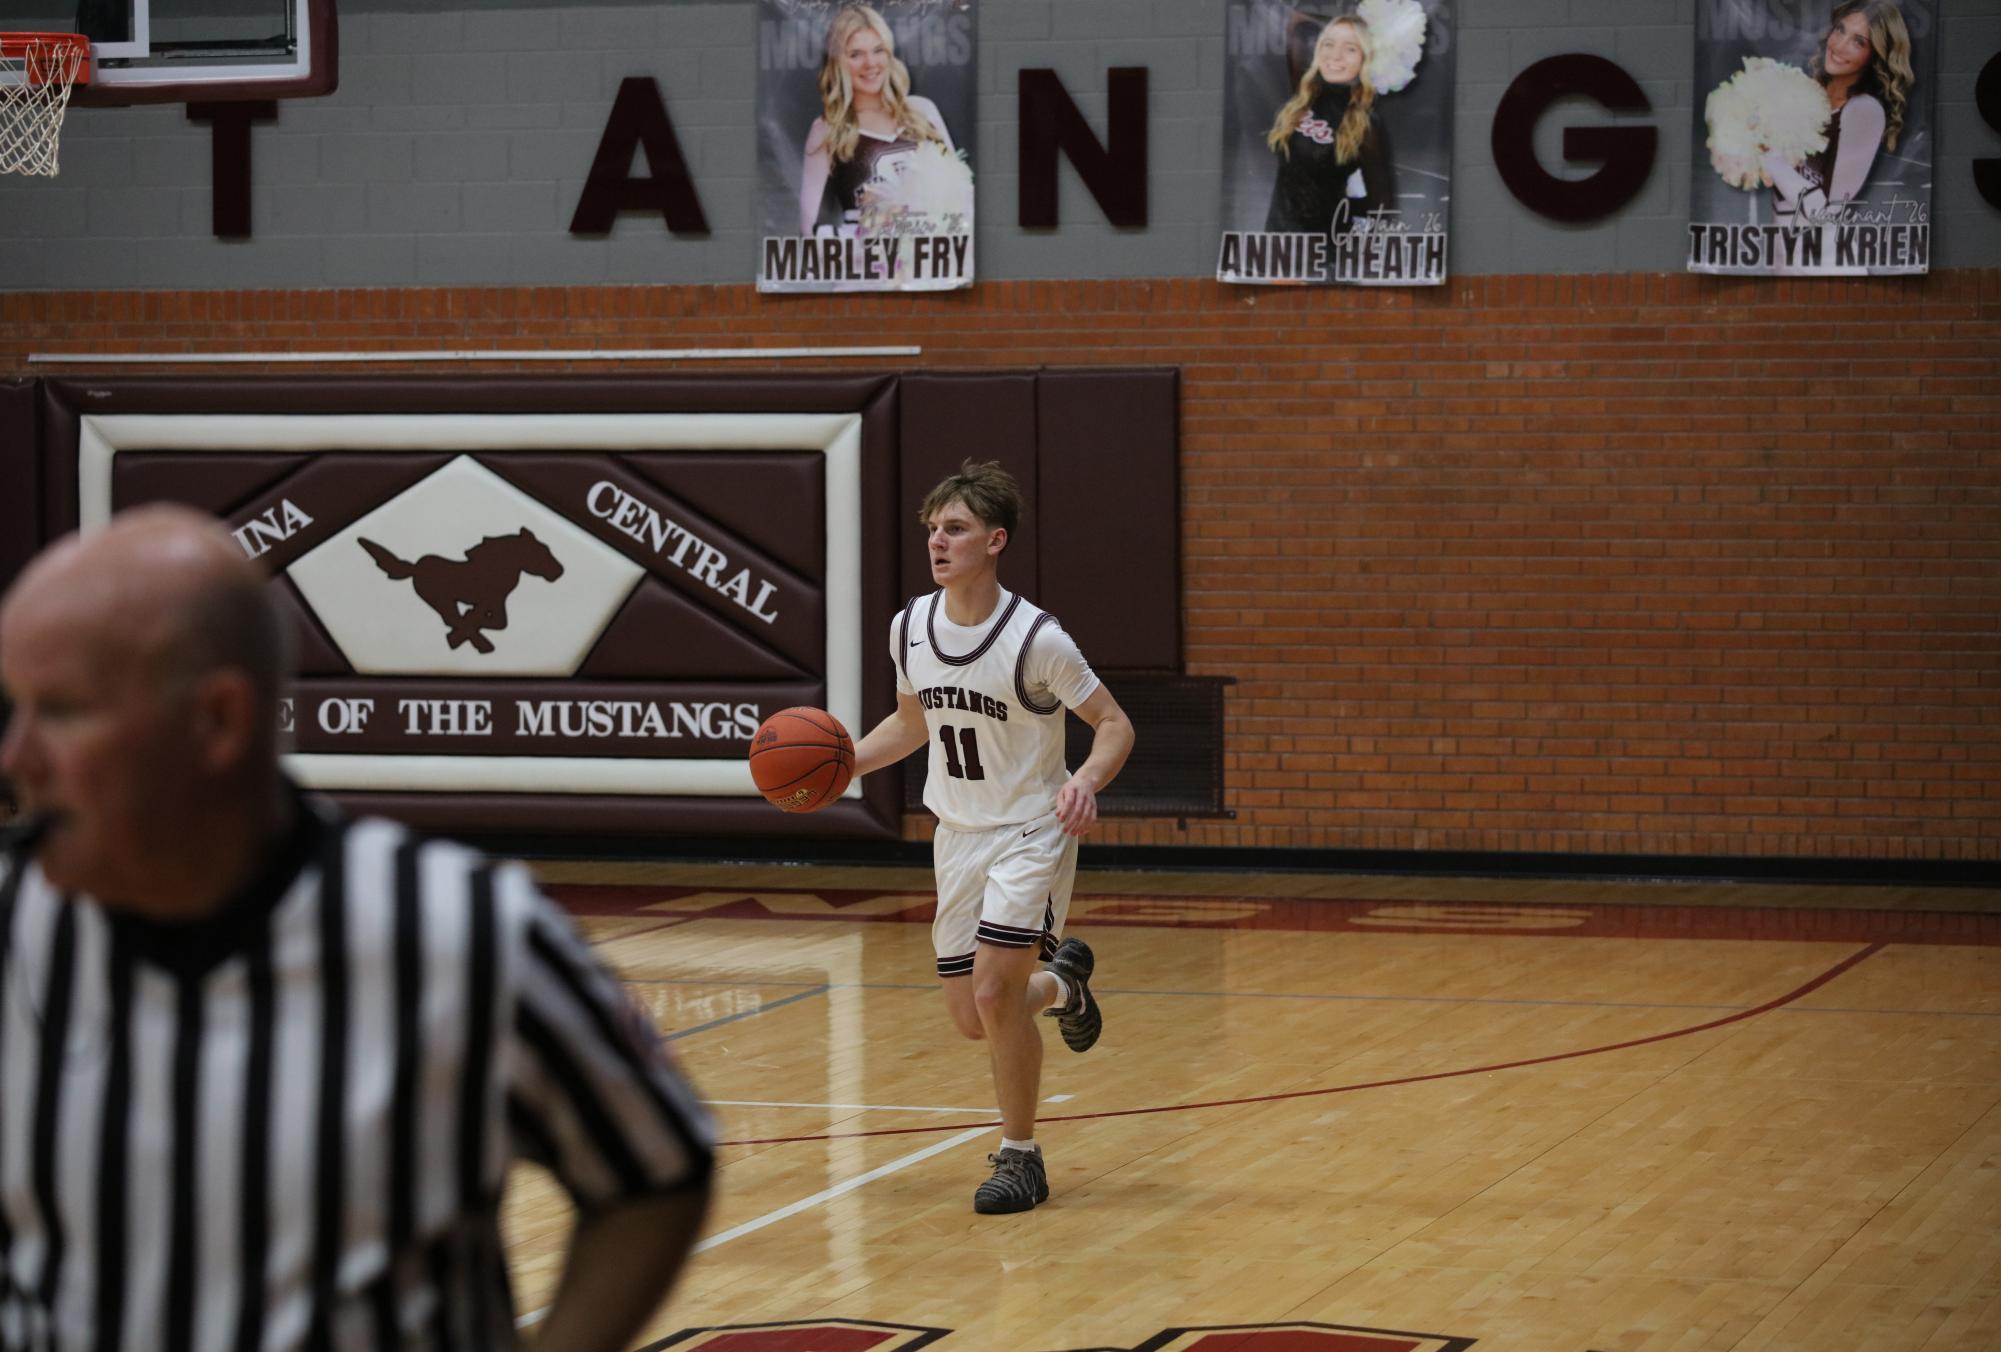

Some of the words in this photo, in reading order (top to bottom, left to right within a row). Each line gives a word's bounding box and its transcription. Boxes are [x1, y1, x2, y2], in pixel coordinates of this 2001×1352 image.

[764, 238, 899, 281] MARLEY
[913, 234, 970, 280] FRY
[1219, 231, 1327, 281] ANNIE
[1336, 233, 1446, 281] HEATH
[1688, 224, 1824, 267] TRISTYN
[1834, 223, 1929, 267] KRIEN
[586, 478, 779, 625] CENTRAL
[318, 697, 375, 734] OF
[398, 699, 492, 736] THE
[516, 700, 760, 739] MUSTANGS
[939, 724, 985, 781] 11
